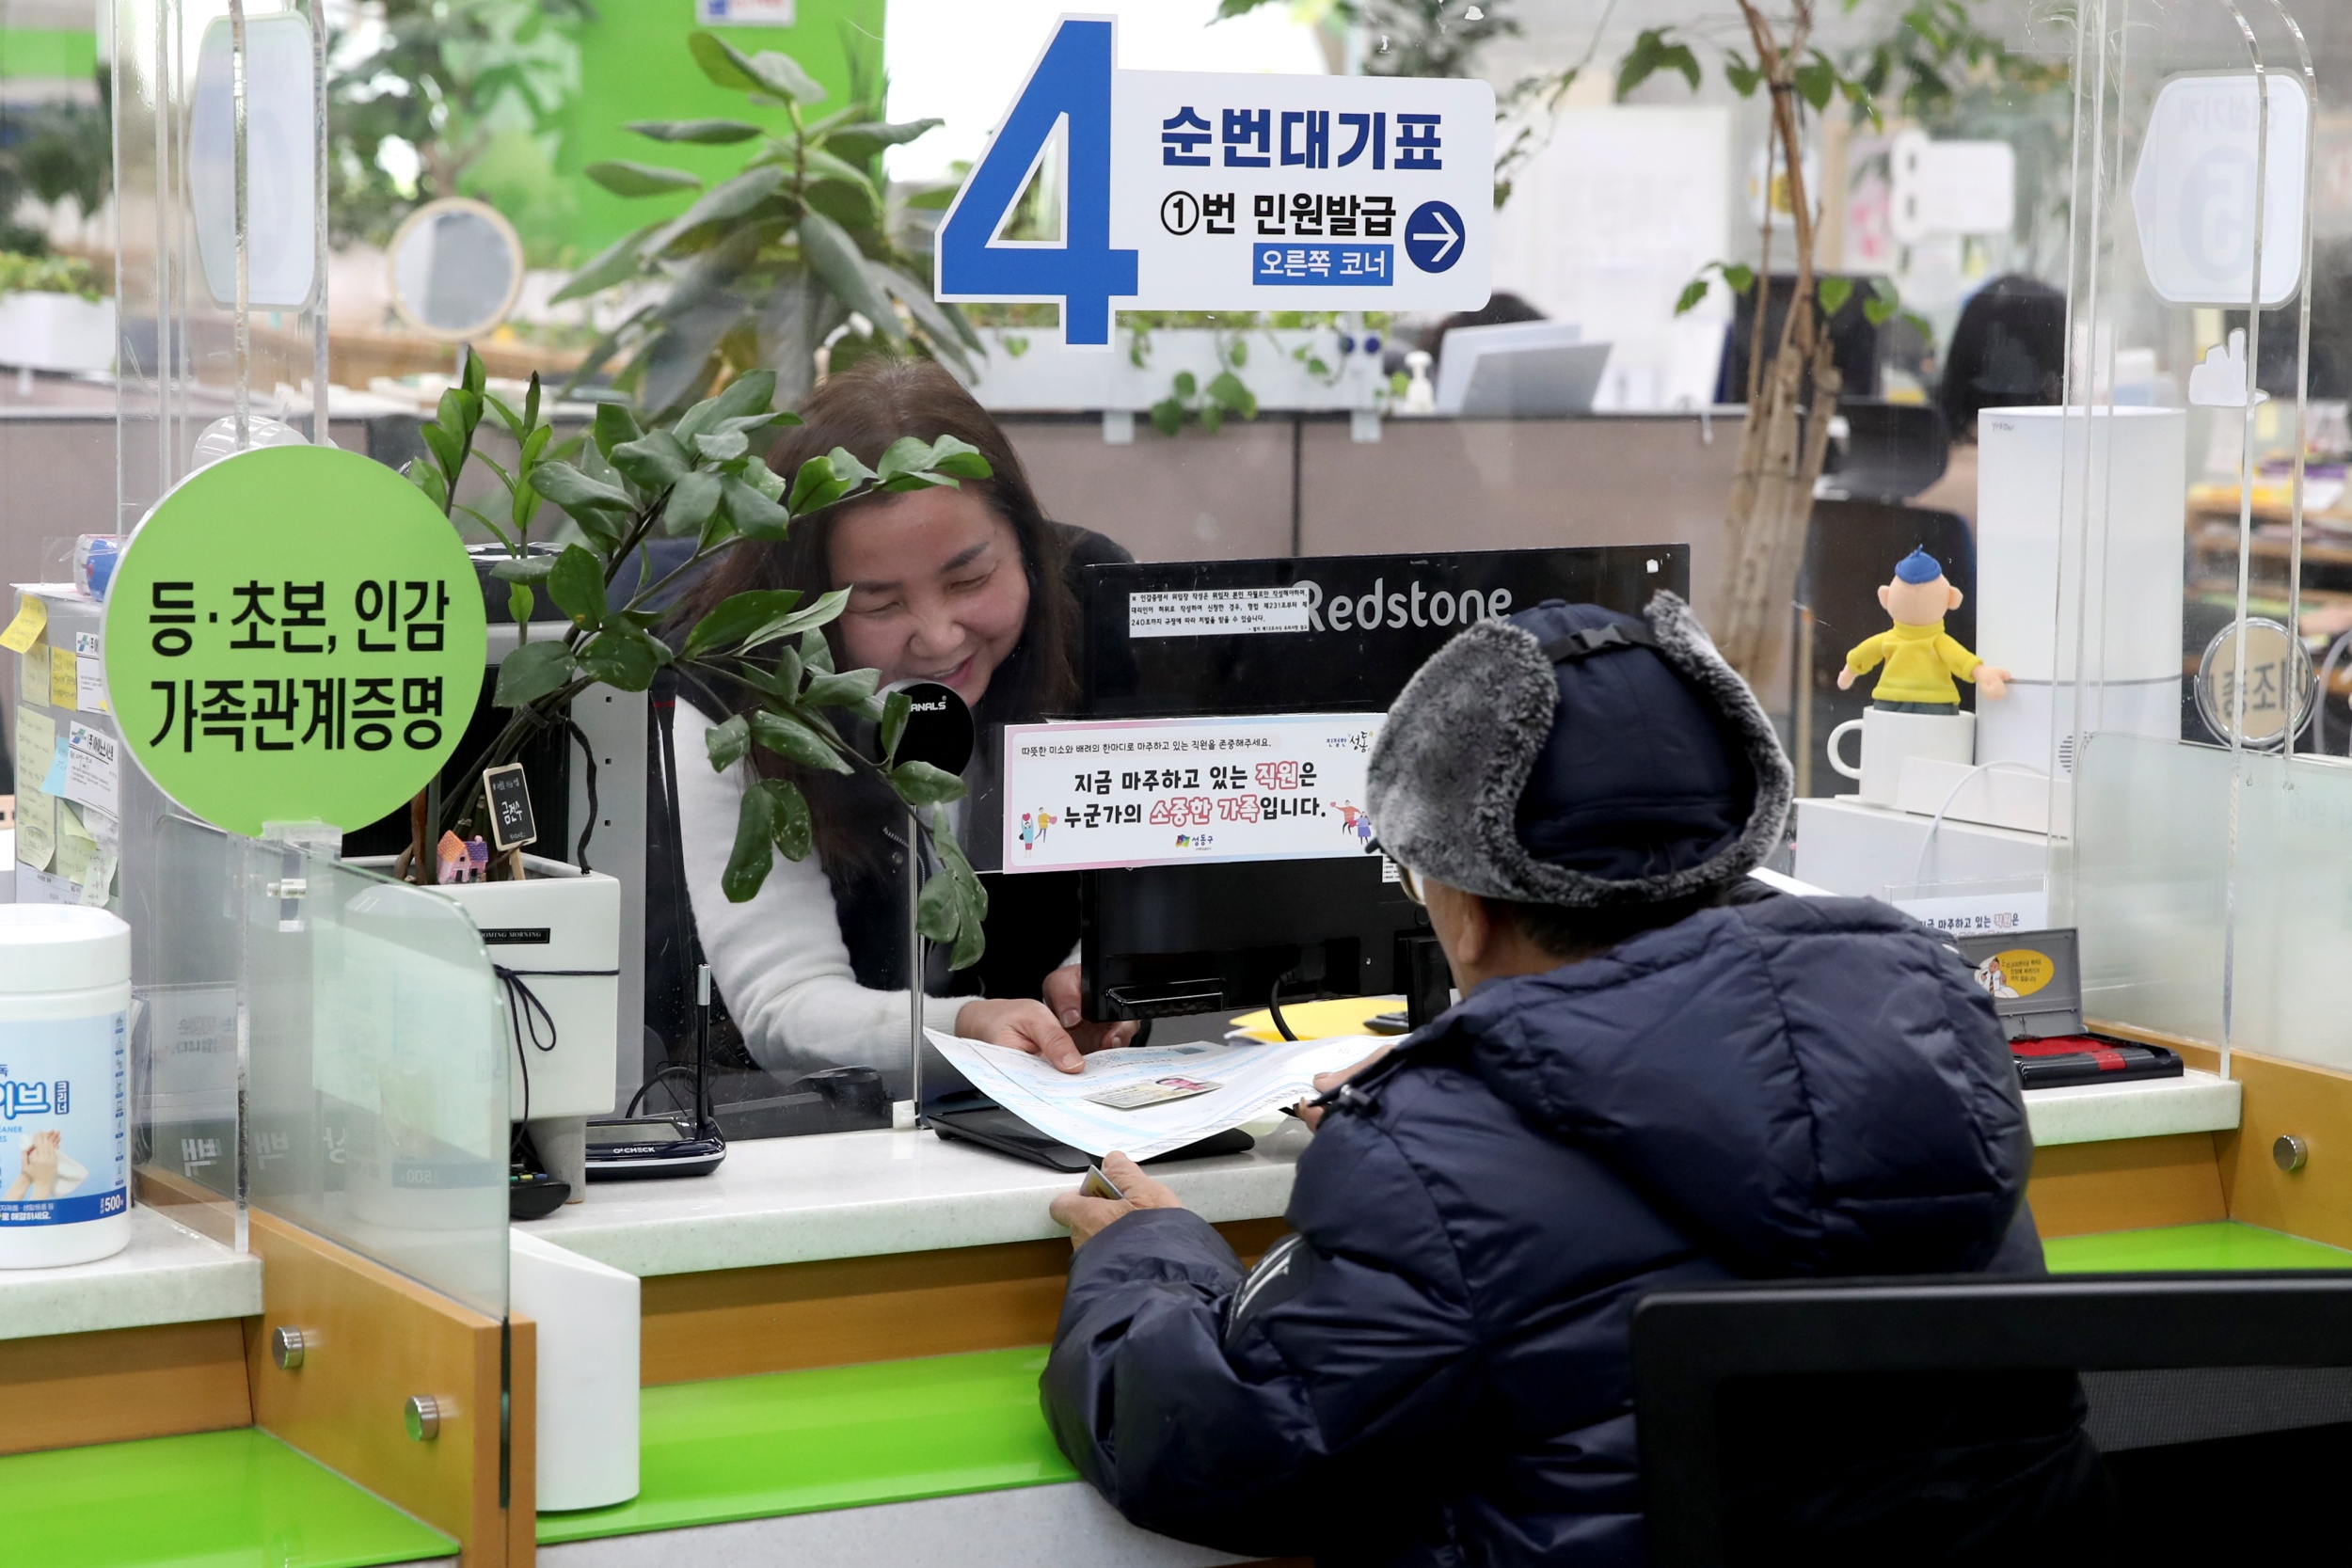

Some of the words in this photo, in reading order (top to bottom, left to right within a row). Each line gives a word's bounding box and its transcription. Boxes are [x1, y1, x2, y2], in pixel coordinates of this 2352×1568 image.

[1161, 106, 1443, 170] 순번대기표
[941, 20, 1138, 345] 4
[1253, 194, 1397, 237] 민원발급
[1260, 249, 1332, 277] 오른쪽
[1341, 250, 1386, 278] 코너
[355, 579, 450, 653] 인감
[1293, 577, 1512, 632] Redstone
[149, 675, 443, 752] 가족관계증명
[1022, 746, 1046, 757] 따뜻한
[1049, 745, 1073, 754] 미소와
[1075, 744, 1100, 752] 배려의
[1103, 742, 1135, 754] 한마디로
[1137, 741, 1169, 752] 마주하고
[1172, 740, 1189, 752] 있는
[1191, 739, 1216, 751] 직원을
[1218, 738, 1272, 751] 존중해주세요.
[1074, 769, 1113, 795] 지금
[1121, 768, 1200, 792] 마주하고
[1209, 765, 1248, 790] 있는
[1255, 760, 1317, 790] 직원은
[1064, 803, 1142, 829] 누군가의
[1149, 797, 1212, 828] 소중한
[1217, 794, 1327, 824] 가족입니다.
[1192, 833, 1214, 847] 성동구
[1938, 916, 1972, 930] 마주하고
[1976, 914, 1992, 928] 있는
